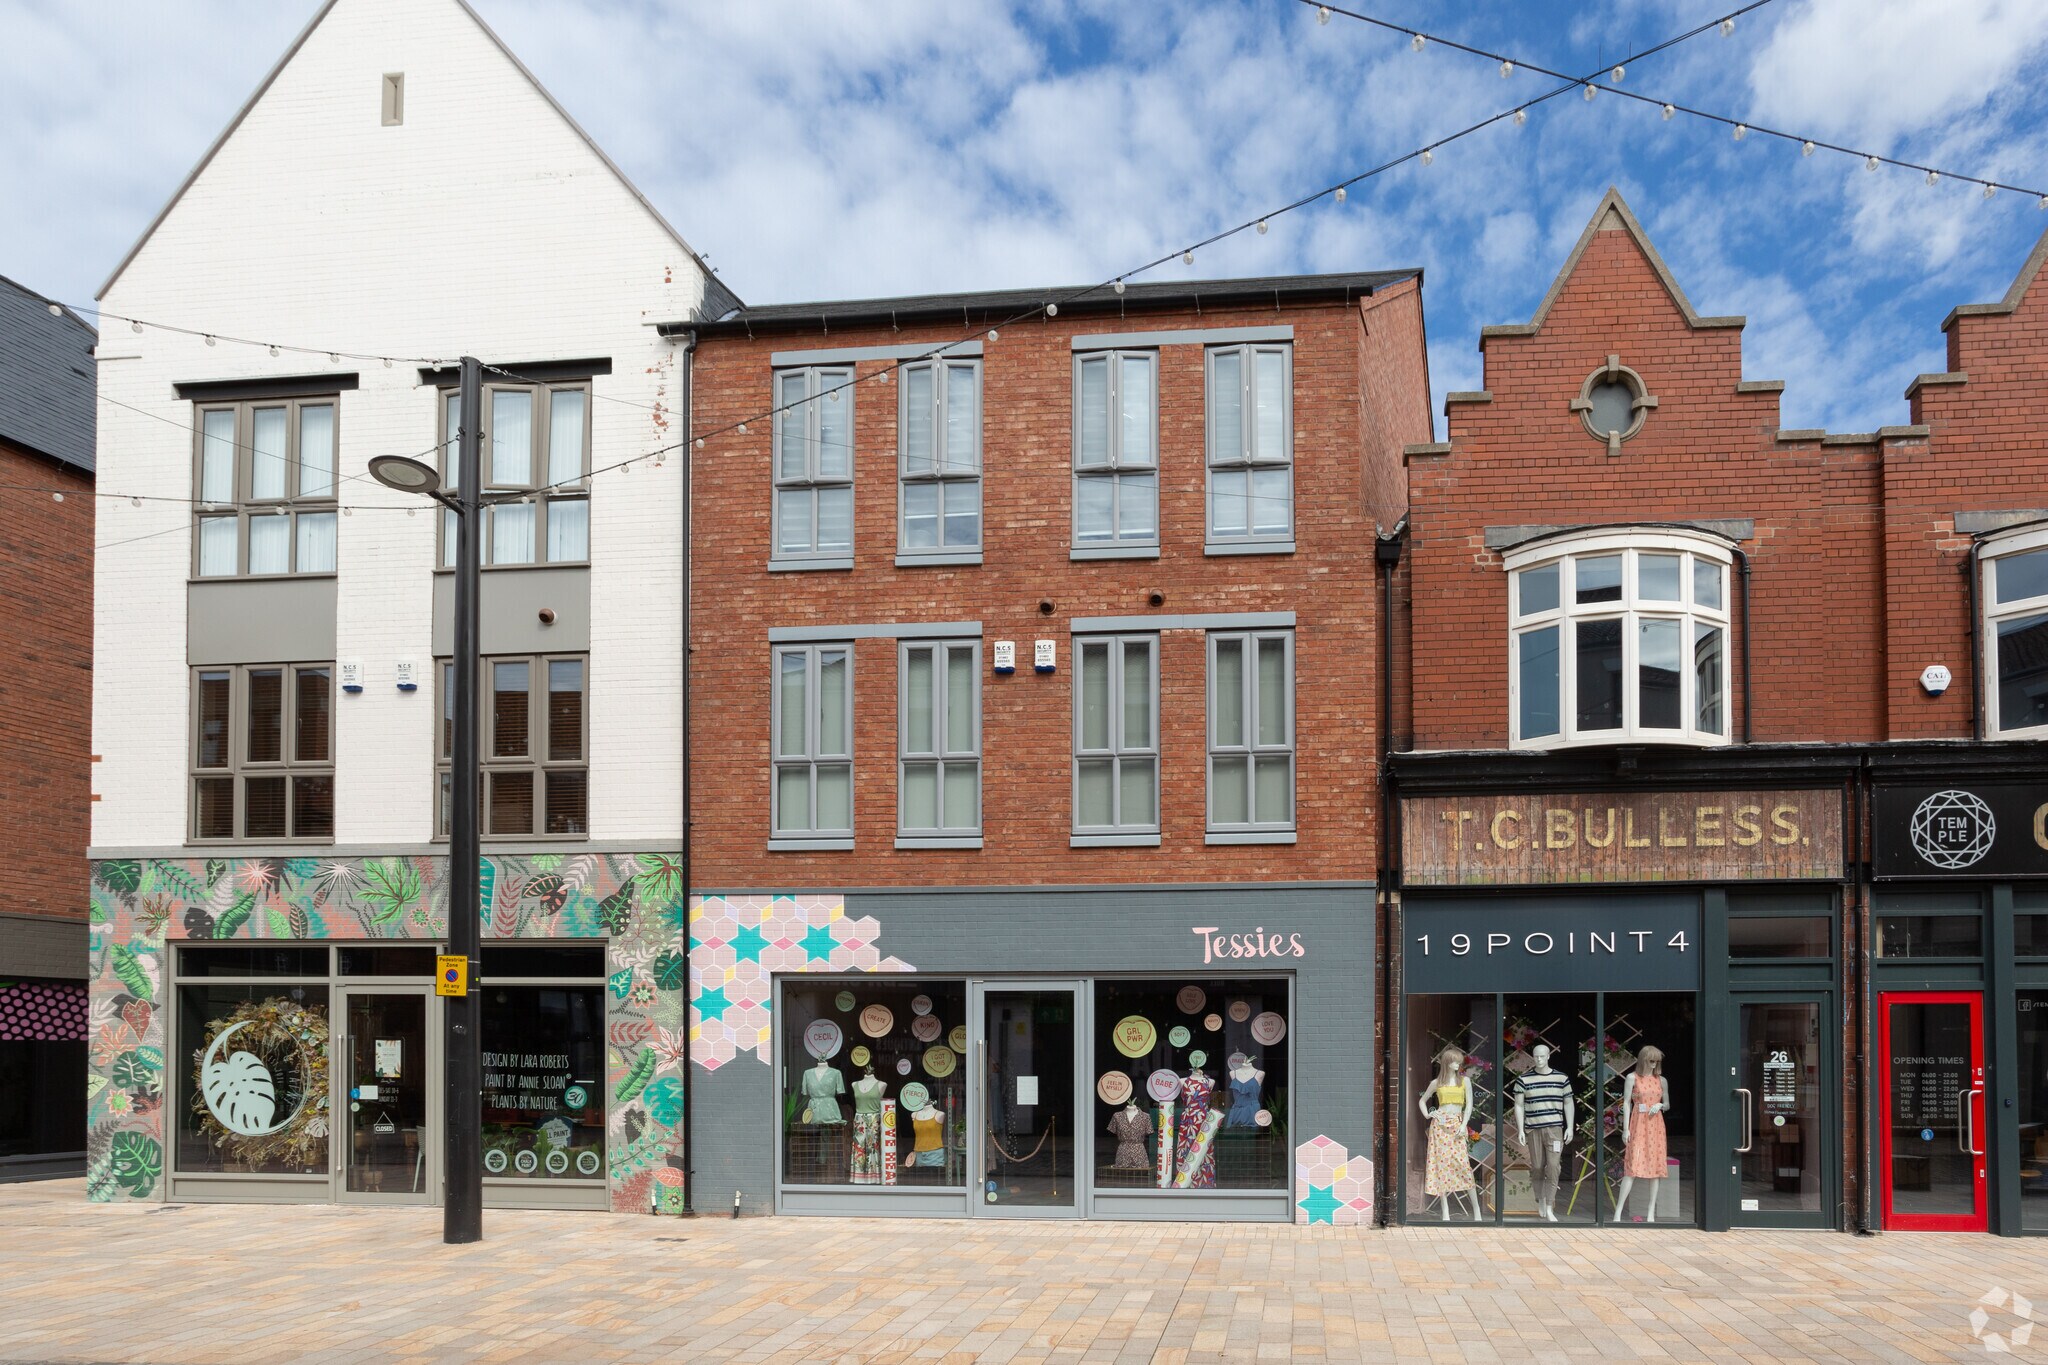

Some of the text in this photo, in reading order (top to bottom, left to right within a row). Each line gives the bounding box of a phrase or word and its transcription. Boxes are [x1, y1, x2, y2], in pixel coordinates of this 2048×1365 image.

[1938, 816, 1968, 829] TEM
[1938, 830, 1968, 842] PLE
[1191, 926, 1305, 965] Tessies
[1417, 930, 1690, 956] 19POINT4
[866, 1013, 887, 1025] CREATE
[813, 1032, 833, 1041] CECIL
[1126, 1027, 1142, 1036] GRL
[1126, 1034, 1144, 1043] PWR
[482, 1052, 570, 1069] DESIGN BY LARA ROBERTS
[1770, 1051, 1788, 1062] 26
[1893, 1056, 1964, 1065] OPENING TIMES
[485, 1073, 505, 1088] PAINT
[507, 1074, 516, 1088] BY
[519, 1075, 540, 1089] ANNIE
[1155, 1078, 1174, 1088] BABE
[905, 1089, 925, 1097] FIERCE
[491, 1094, 558, 1111] PLANTS BY NATURE
[553, 1129, 568, 1138] PAINT
